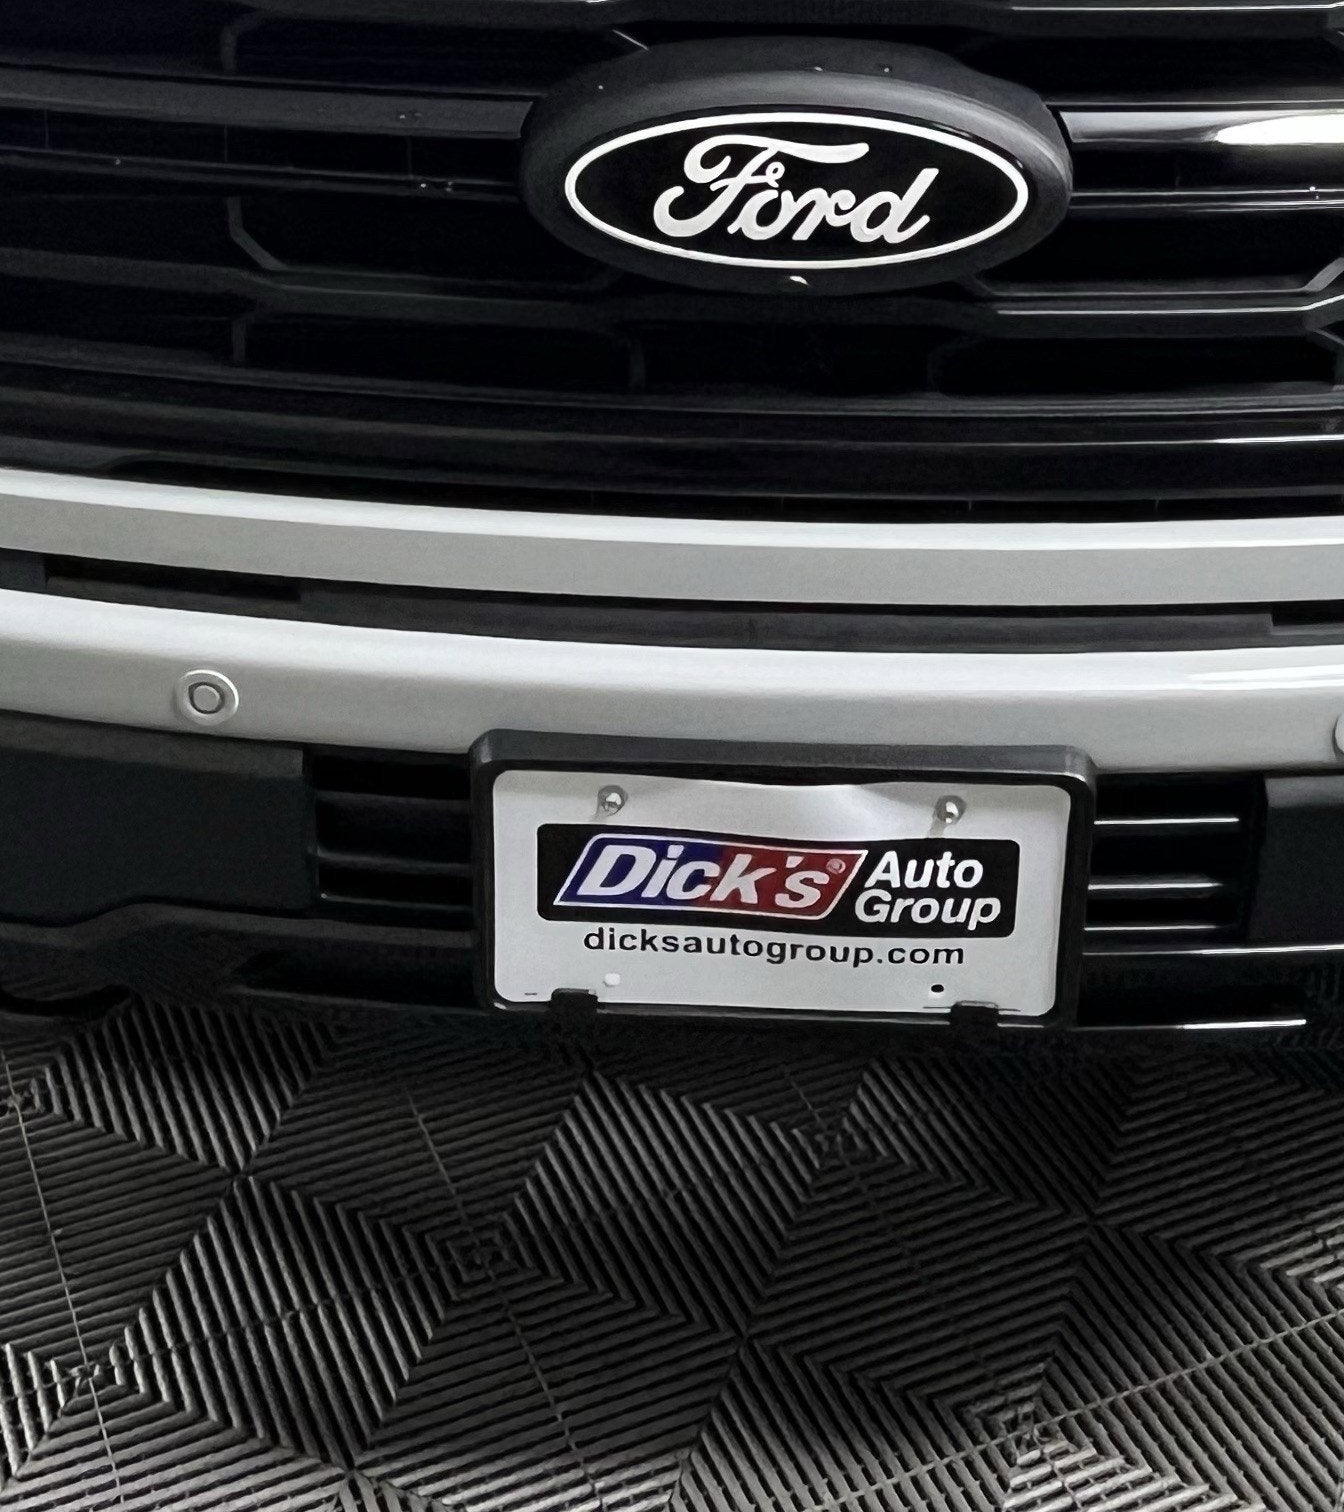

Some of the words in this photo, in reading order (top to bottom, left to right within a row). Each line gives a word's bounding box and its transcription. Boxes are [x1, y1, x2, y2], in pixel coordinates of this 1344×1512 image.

[653, 134, 939, 244] Ford
[576, 843, 829, 909] Dick's
[865, 850, 985, 889] Auto
[855, 890, 1002, 931] Group
[582, 927, 966, 968] dicksautogroup.com
